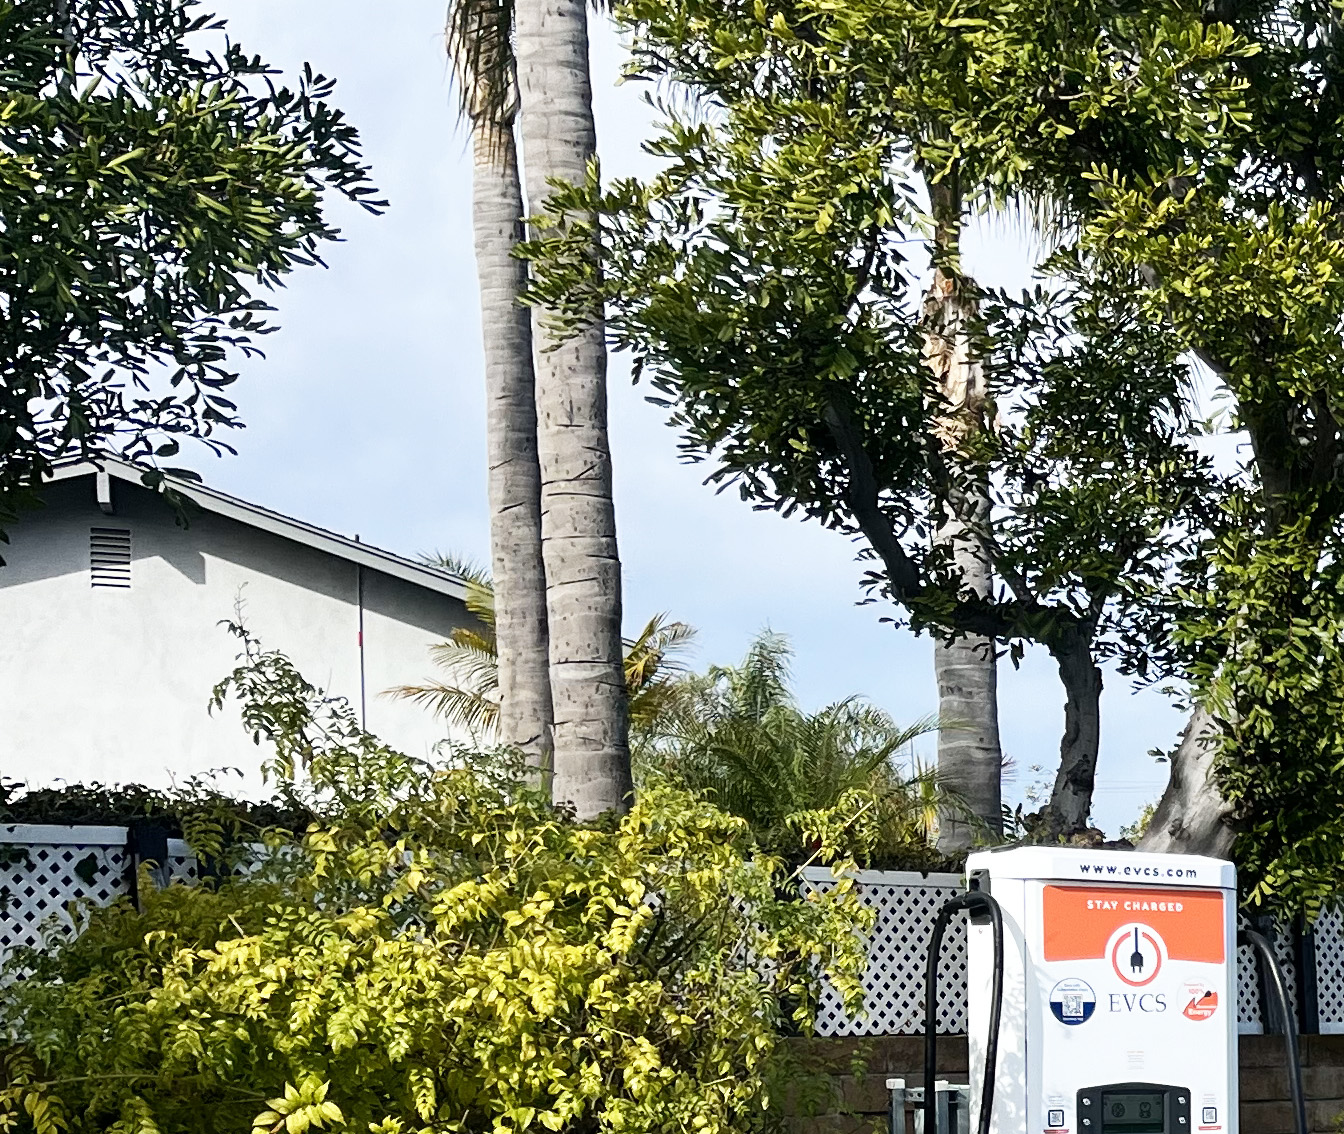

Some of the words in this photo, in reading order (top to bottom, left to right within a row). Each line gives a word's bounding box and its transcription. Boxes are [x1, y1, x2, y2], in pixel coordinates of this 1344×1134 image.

[1080, 864, 1197, 878] www.evcs.com
[1086, 900, 1119, 910] STAY
[1124, 901, 1184, 912] CHARGED
[1108, 993, 1167, 1013] EVCS
